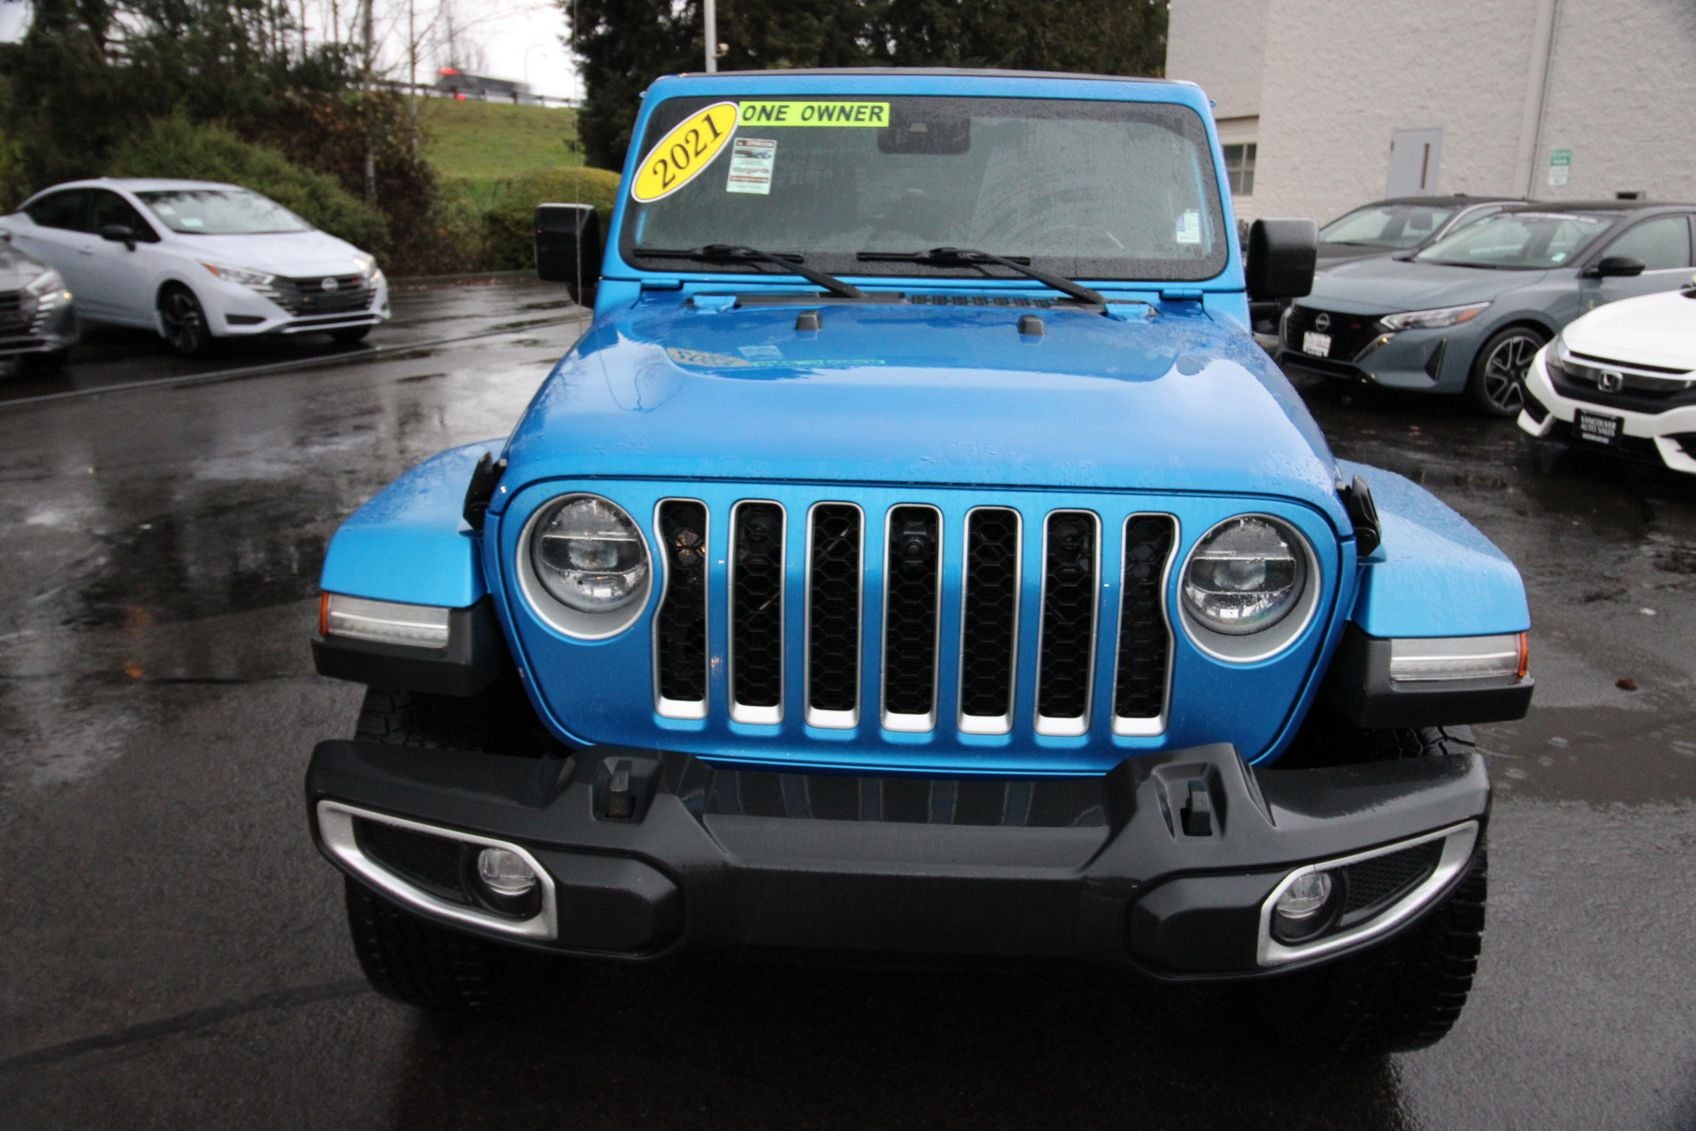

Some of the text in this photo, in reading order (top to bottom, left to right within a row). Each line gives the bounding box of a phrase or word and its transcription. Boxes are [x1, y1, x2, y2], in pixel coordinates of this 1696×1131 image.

[742, 105, 884, 122] ONE OWNER
[652, 113, 723, 189] 2021
